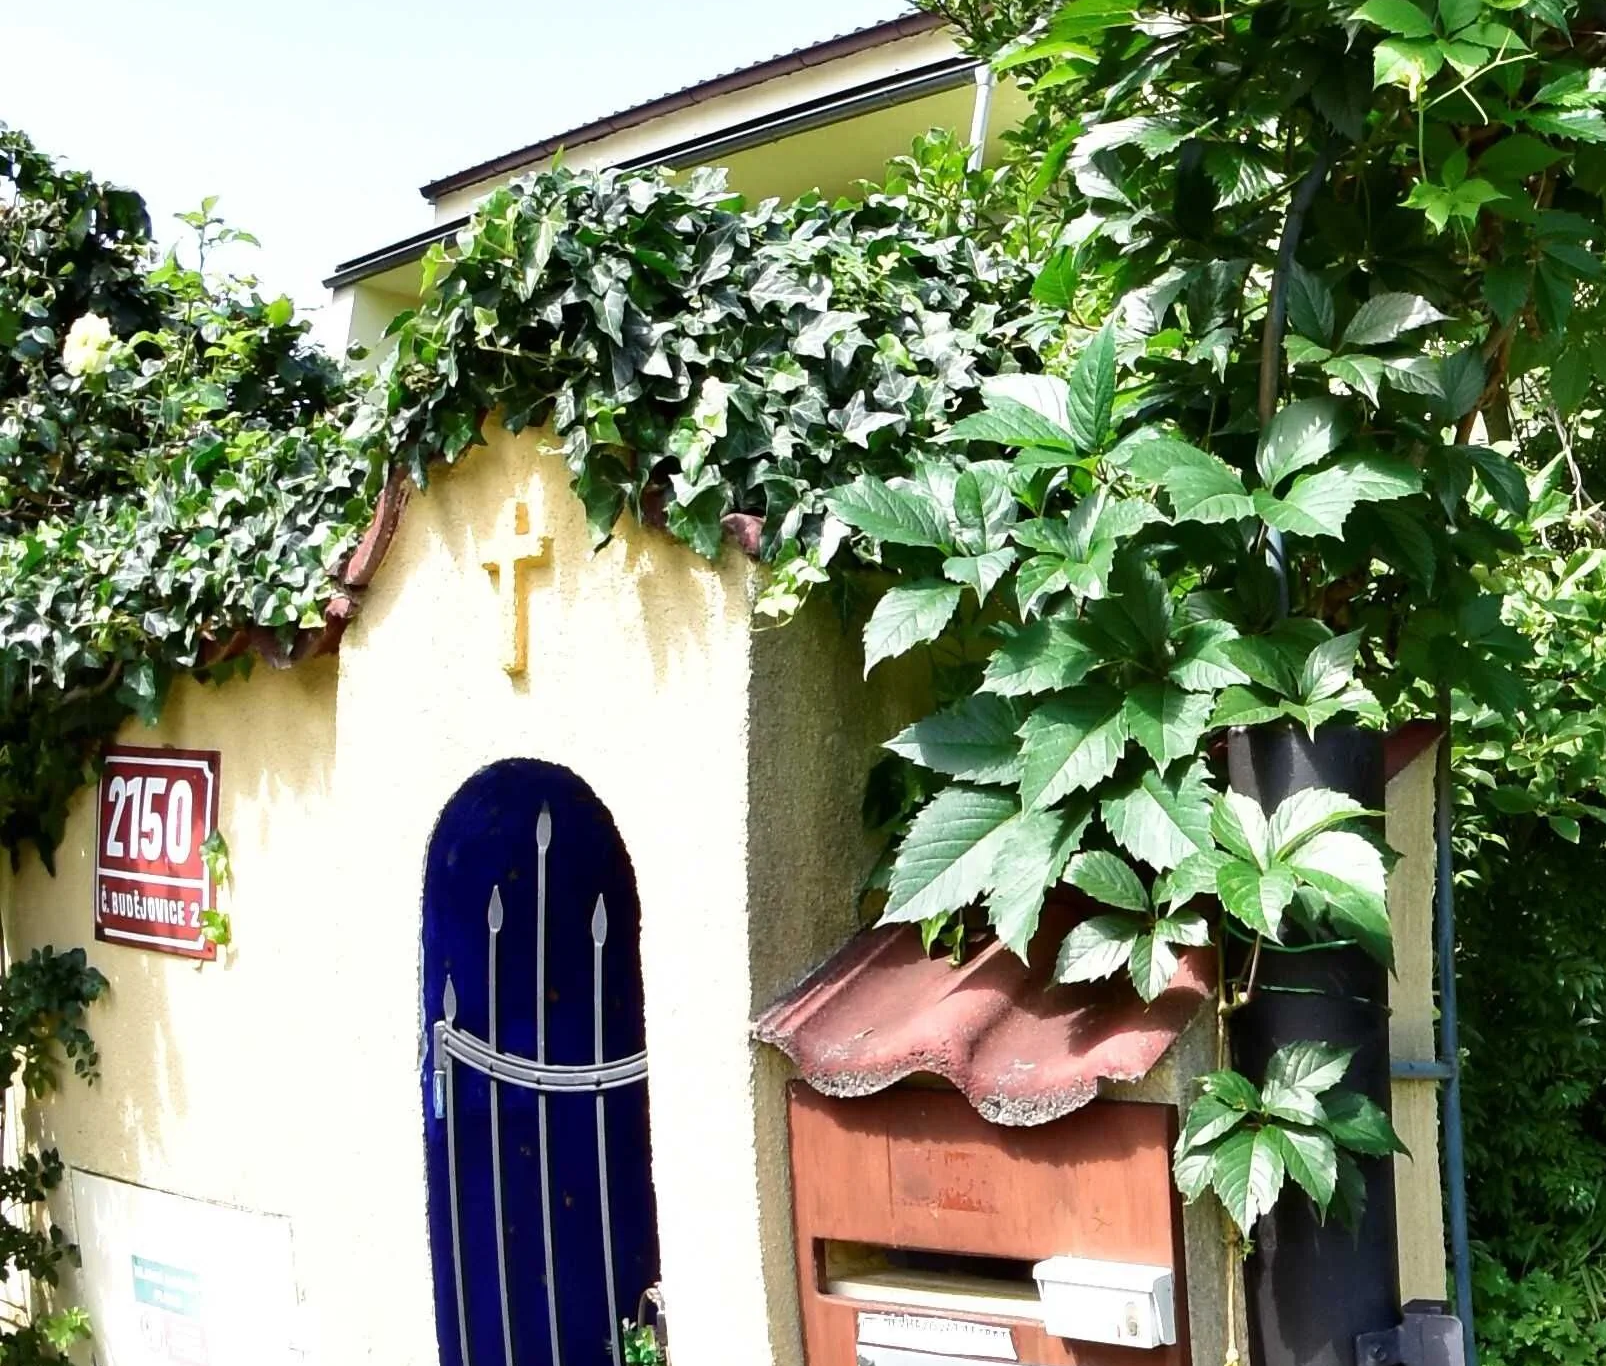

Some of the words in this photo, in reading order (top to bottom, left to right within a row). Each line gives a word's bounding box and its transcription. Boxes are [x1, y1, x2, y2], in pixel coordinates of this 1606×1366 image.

[106, 776, 192, 864] 2150
[101, 884, 110, 913] Č.
[112, 889, 185, 926] BUDĚJOVICE
[190, 902, 200, 927] 2
